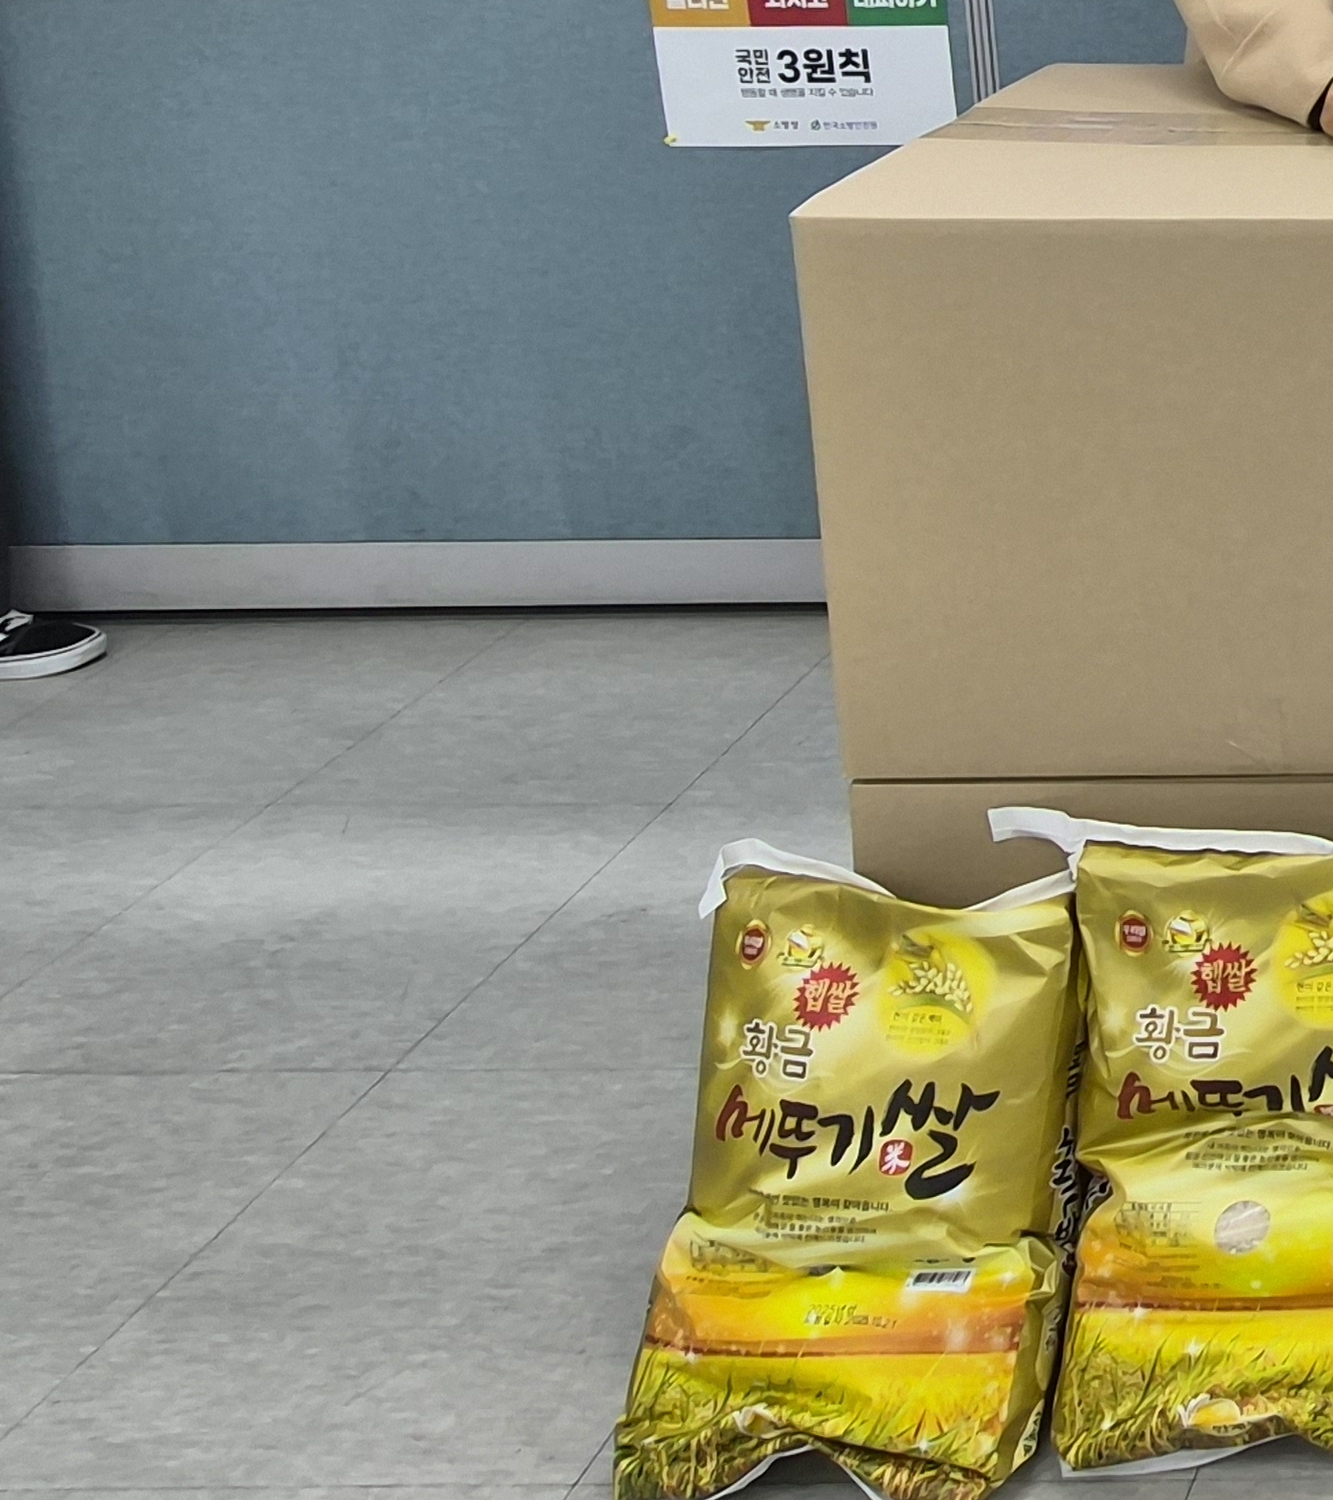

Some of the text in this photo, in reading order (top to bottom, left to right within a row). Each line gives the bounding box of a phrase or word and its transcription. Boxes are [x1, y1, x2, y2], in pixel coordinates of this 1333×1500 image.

[735, 48, 769, 66] 국민
[776, 48, 873, 84] 3원칙
[738, 66, 771, 85] 안전
[1200, 959, 1251, 993] 햅쌀
[804, 979, 857, 1014] 햅쌀
[742, 1019, 814, 1080] 황금
[1135, 1005, 1226, 1064] 황금
[714, 1078, 1001, 1201] 메뚜기쌀
